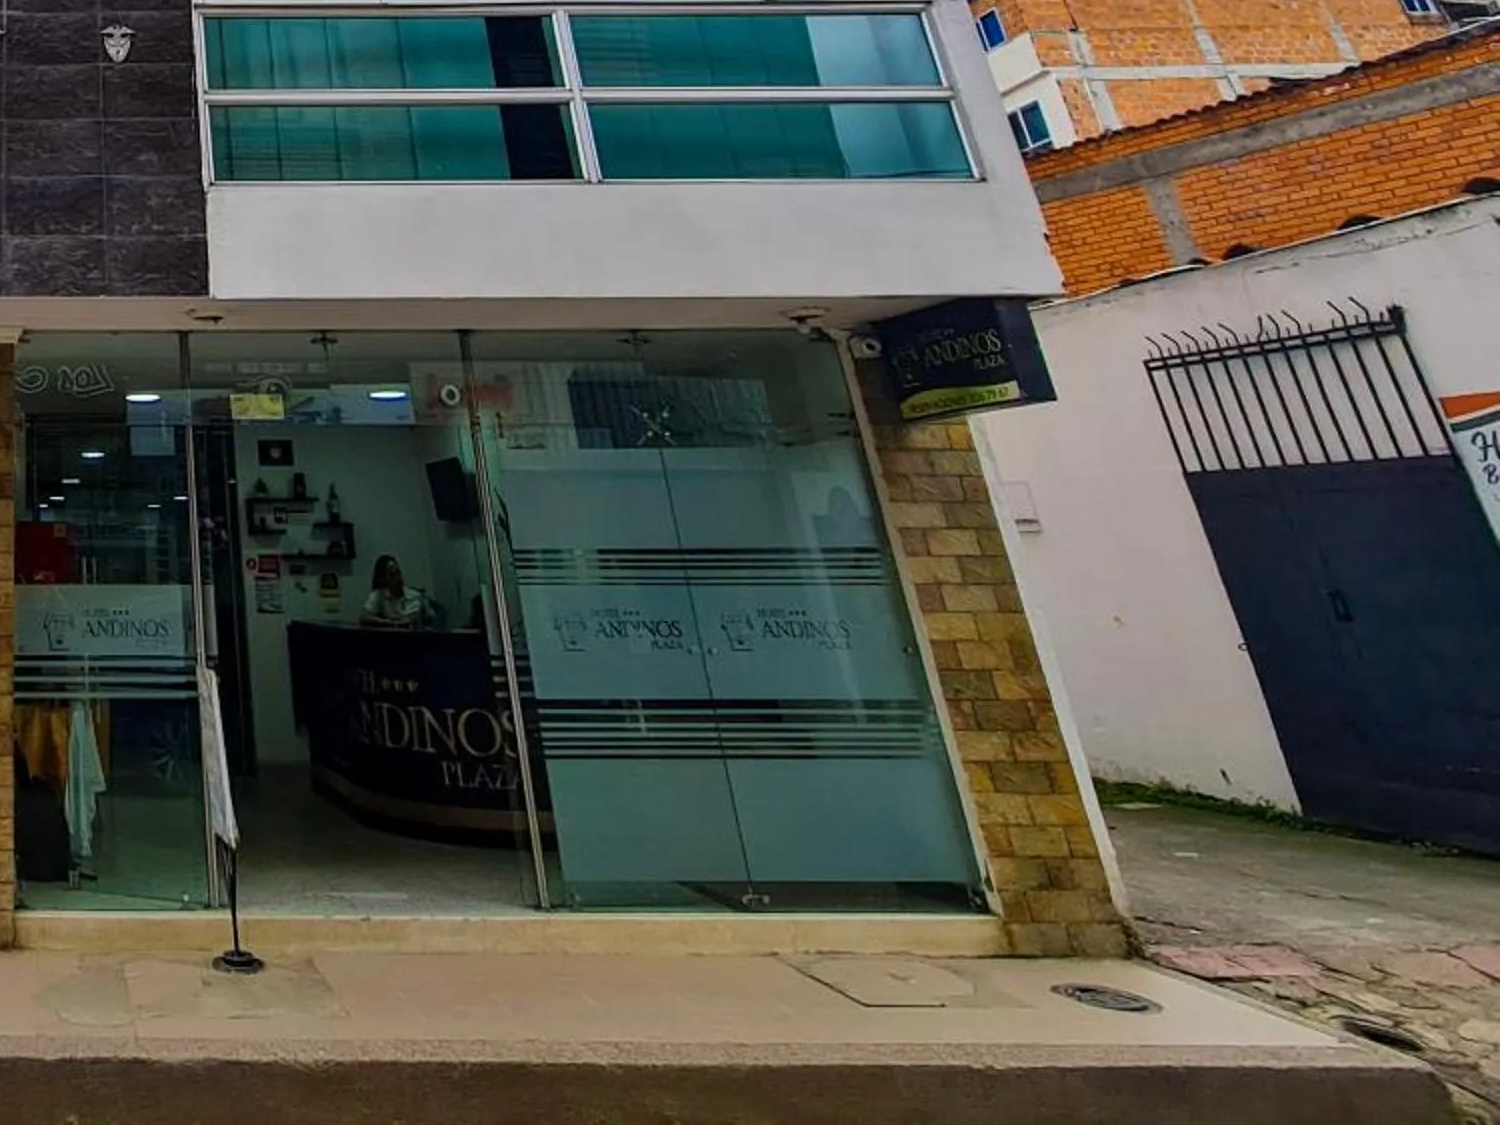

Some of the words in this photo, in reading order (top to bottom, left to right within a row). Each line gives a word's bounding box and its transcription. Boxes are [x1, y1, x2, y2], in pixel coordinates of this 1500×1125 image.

[924, 328, 1002, 365] ANDINOS
[84, 619, 171, 638] ANDINOS
[761, 619, 852, 639] ANDINOS
